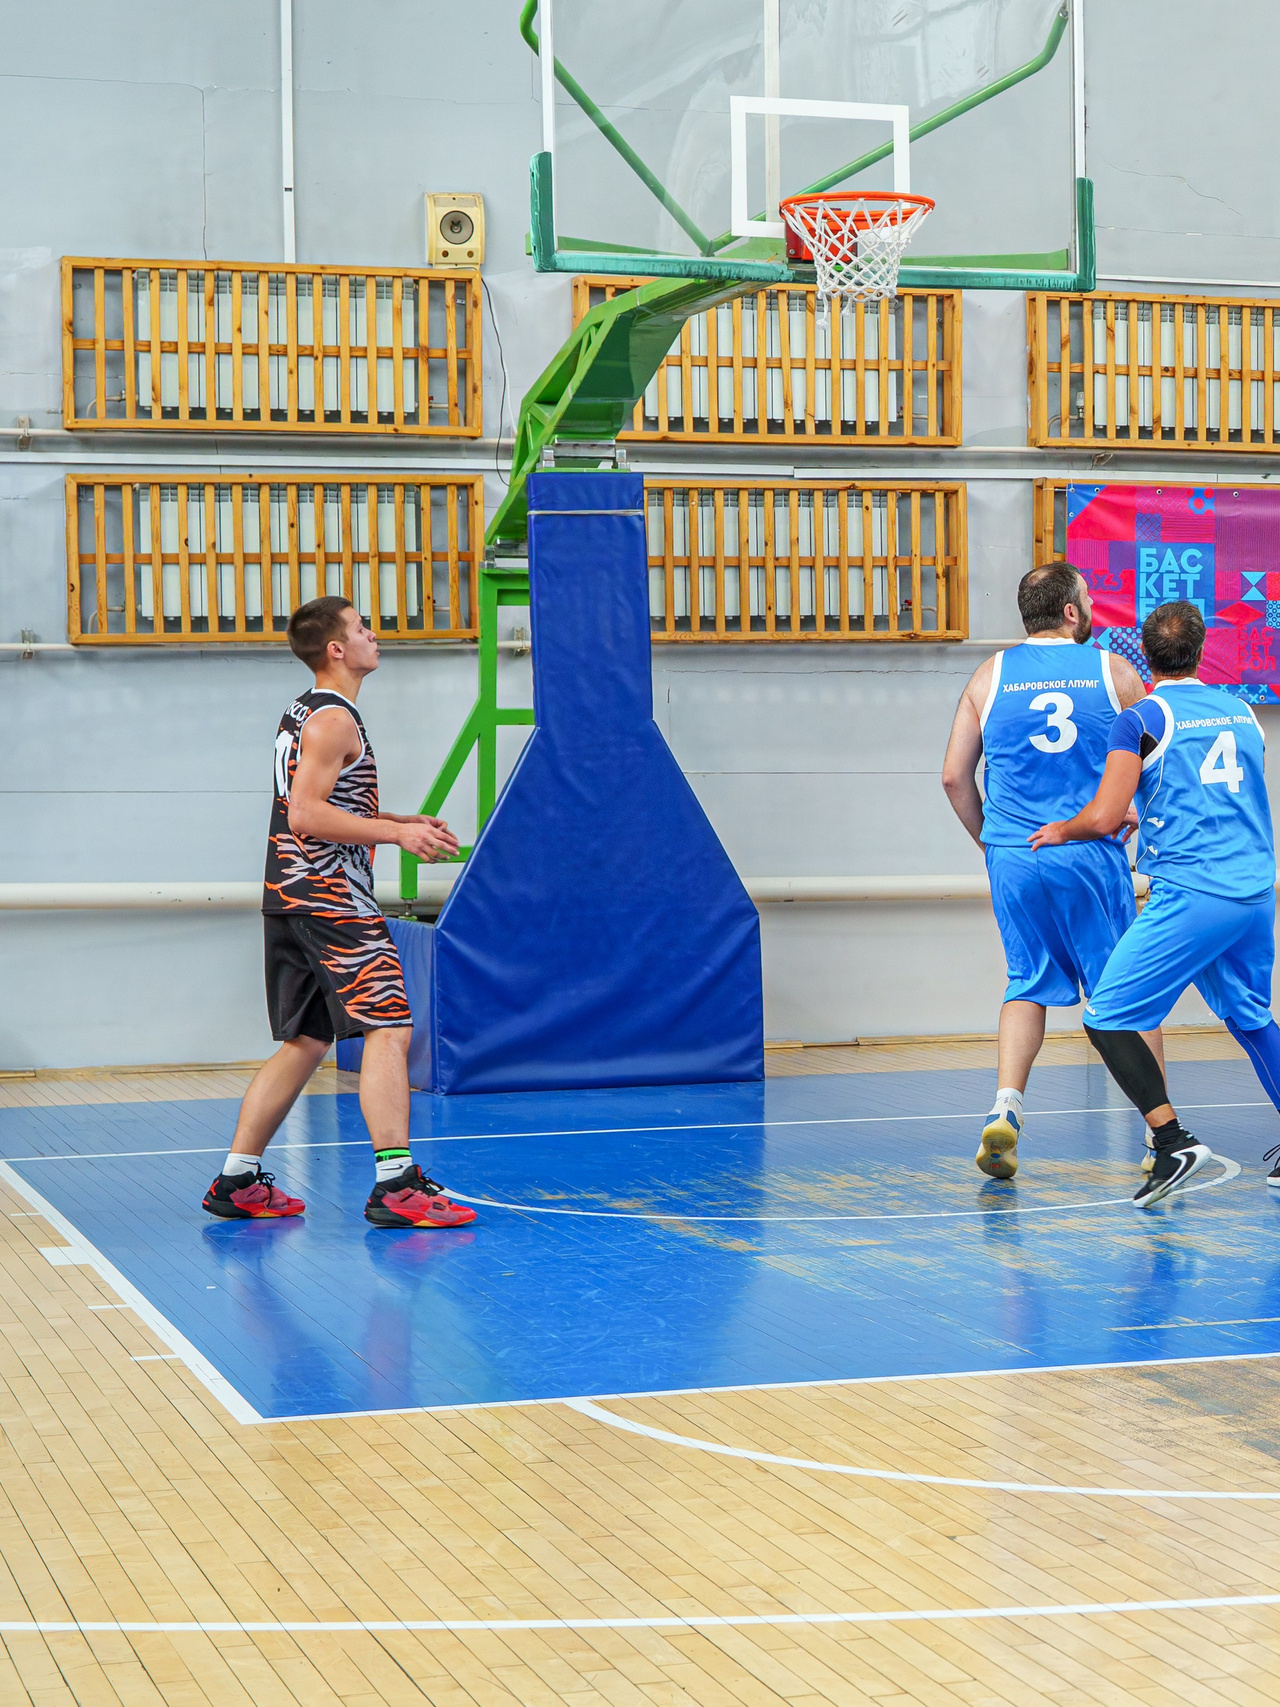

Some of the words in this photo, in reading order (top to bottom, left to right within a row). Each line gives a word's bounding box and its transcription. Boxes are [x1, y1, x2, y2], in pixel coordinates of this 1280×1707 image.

[1139, 547, 1203, 573] БАС
[1139, 572, 1201, 598] КЕТ
[1002, 680, 1067, 693] ХАБАРОВСКОЕ
[1067, 679, 1100, 689] ЛПУМГ
[1028, 691, 1078, 754] 3
[1175, 716, 1233, 731] ХАБАРОВСКОЕ
[1199, 730, 1244, 794] 4
